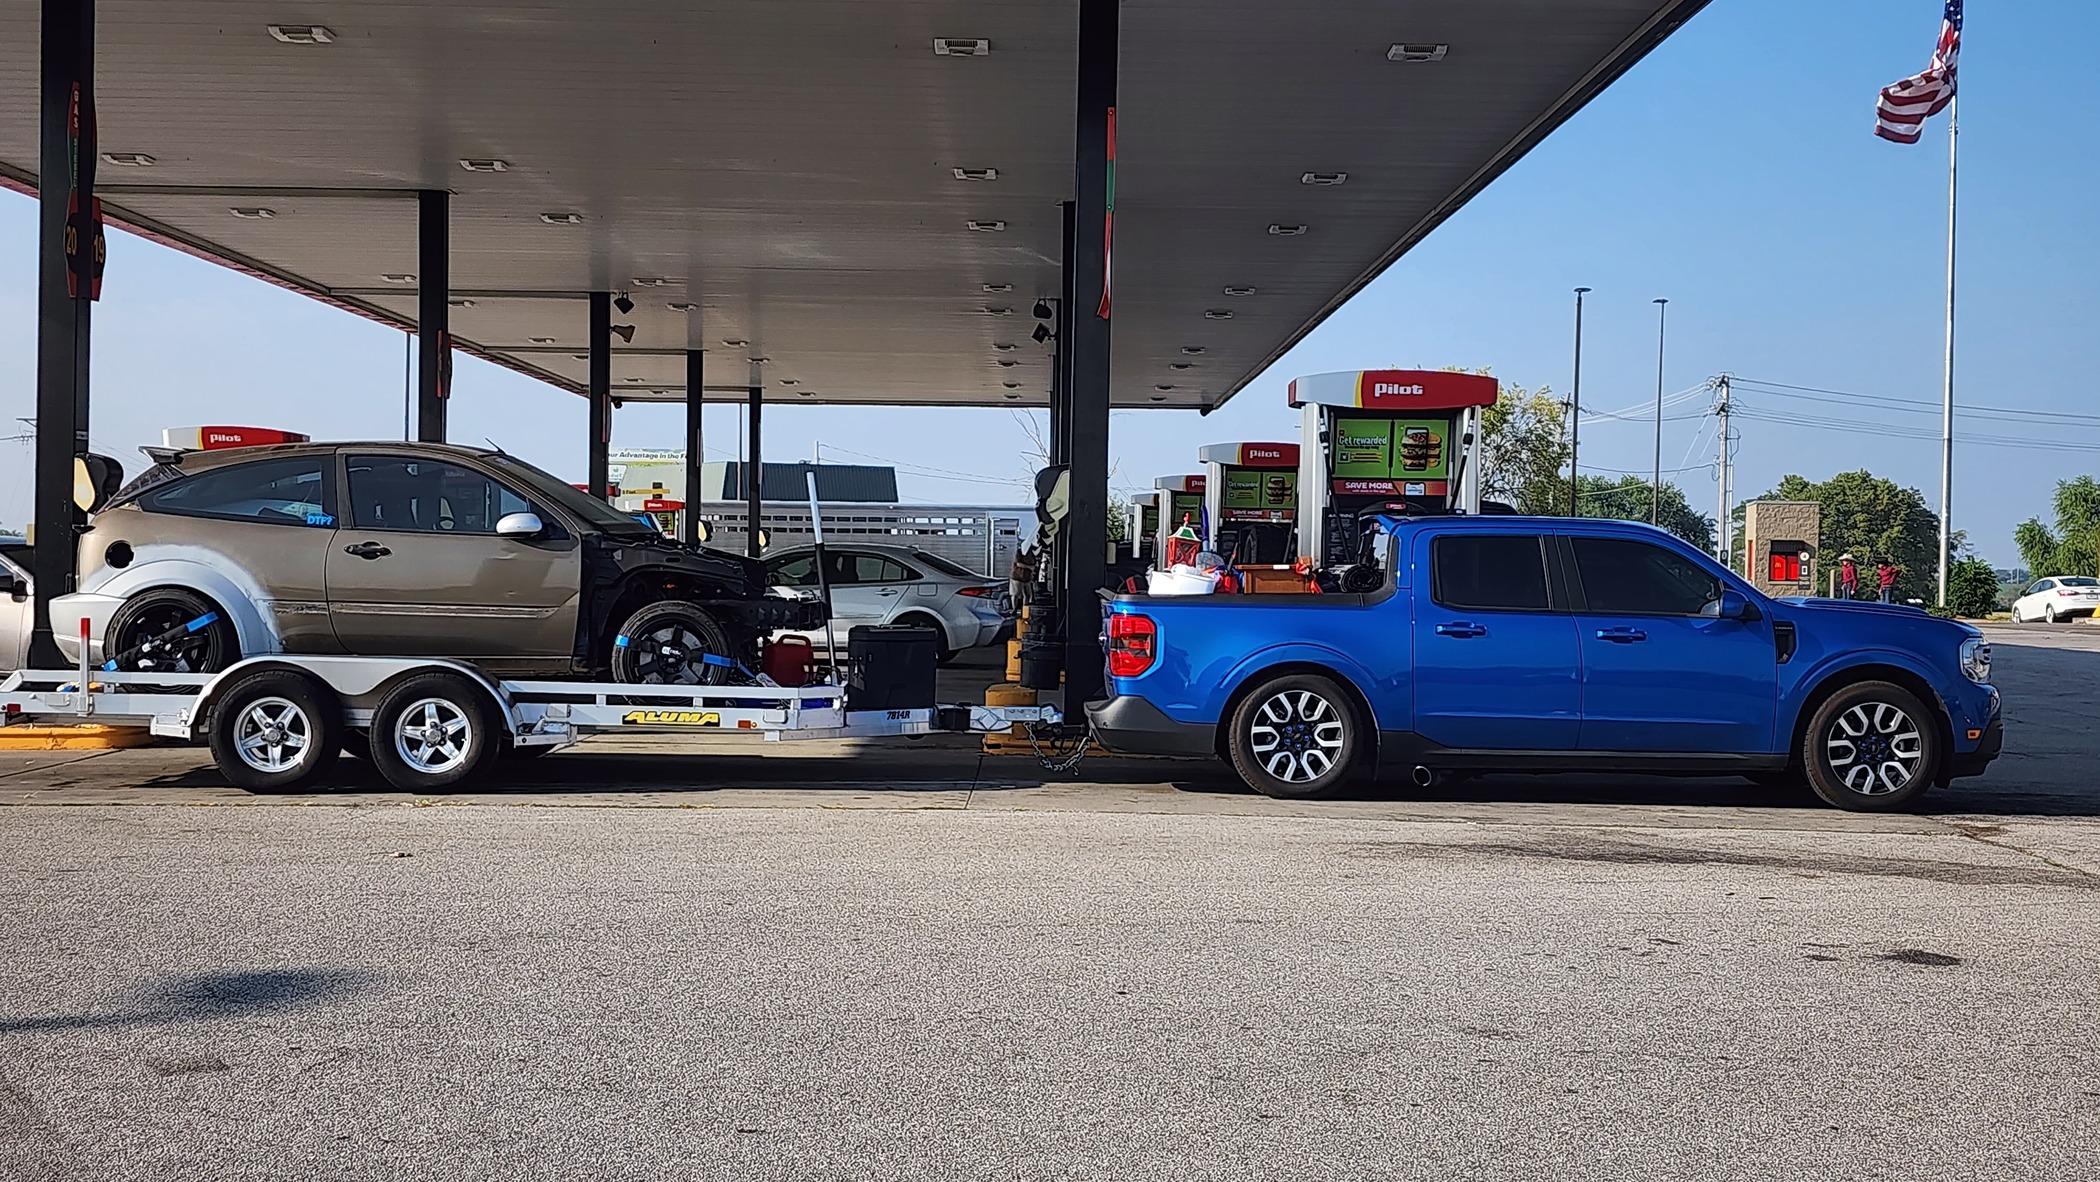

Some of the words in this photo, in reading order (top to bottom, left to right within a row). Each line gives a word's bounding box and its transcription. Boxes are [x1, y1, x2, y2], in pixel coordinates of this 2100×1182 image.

[66, 225, 77, 256] 20
[94, 234, 104, 264] 19
[1339, 435, 1352, 445] Get
[1353, 435, 1388, 445] rewarded
[619, 451, 659, 460] Advantage
[1368, 482, 1393, 490] MORE
[624, 711, 719, 725] ALUMA
[886, 710, 911, 720] 7814R
